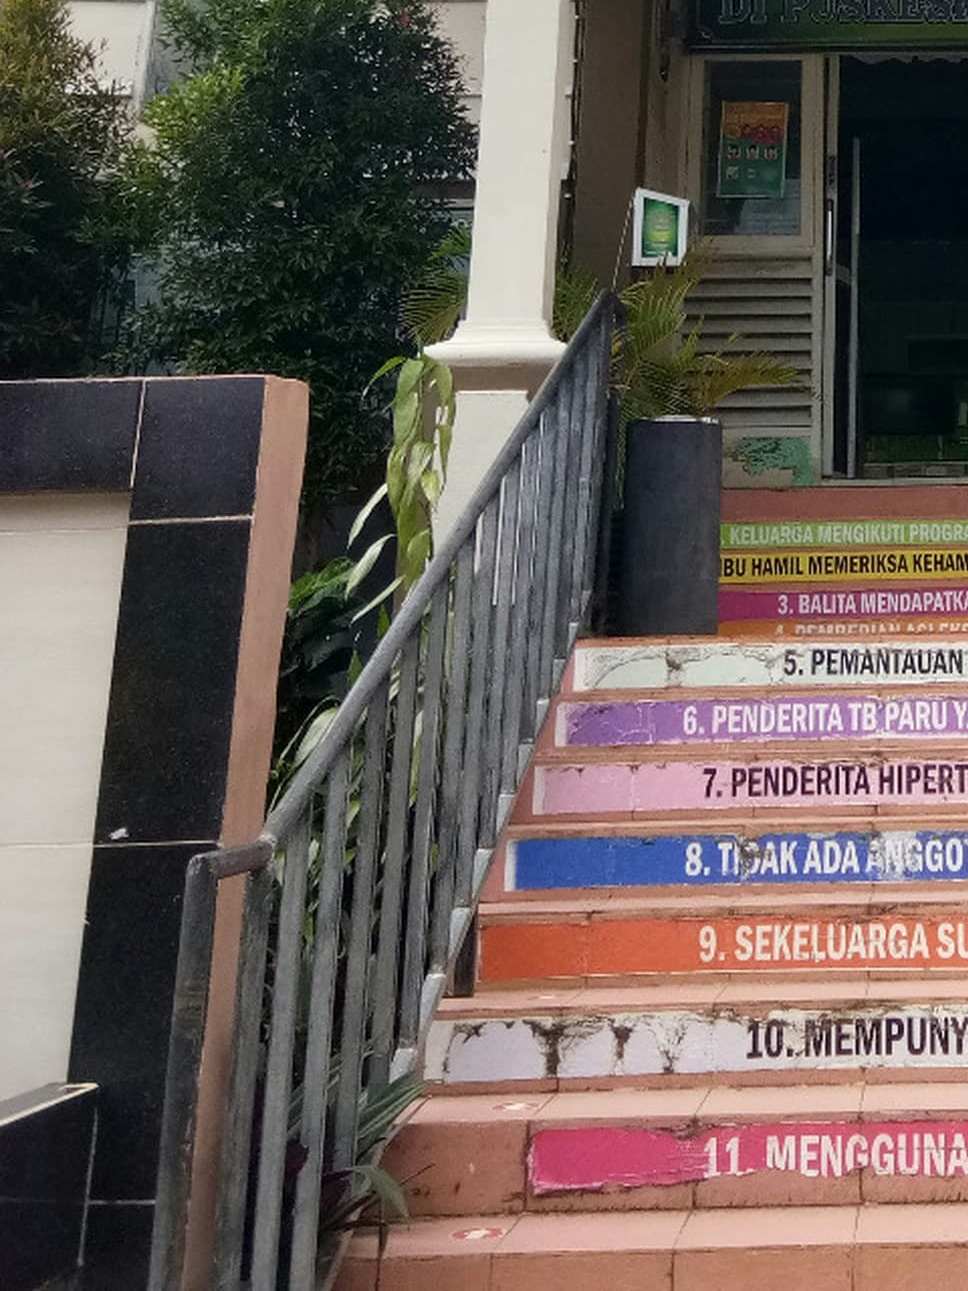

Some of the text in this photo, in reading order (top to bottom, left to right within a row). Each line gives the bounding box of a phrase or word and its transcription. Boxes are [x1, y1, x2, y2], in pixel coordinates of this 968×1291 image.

[730, 525, 813, 545] KELUARGA
[817, 524, 905, 544] MENGIKUTI
[751, 556, 804, 576] HAMIL
[808, 555, 909, 575] MEMERIKSA
[777, 594, 794, 614] 3.
[798, 593, 857, 614] BALITA
[783, 650, 805, 676] 5.
[811, 648, 963, 676] PEMANTAUAN
[683, 706, 705, 735] 6.
[711, 702, 844, 734] PENDERITA
[851, 702, 877, 731] TB
[884, 701, 948, 731] PARU
[702, 768, 723, 798] 7.
[731, 765, 870, 797] PENDERITA
[685, 842, 711, 876] 8.
[803, 840, 860, 874] ADA
[699, 925, 725, 962] 9.
[735, 922, 929, 962] SEKELUARGA
[747, 1019, 797, 1058] 10.
[703, 1137, 755, 1178] 11.
